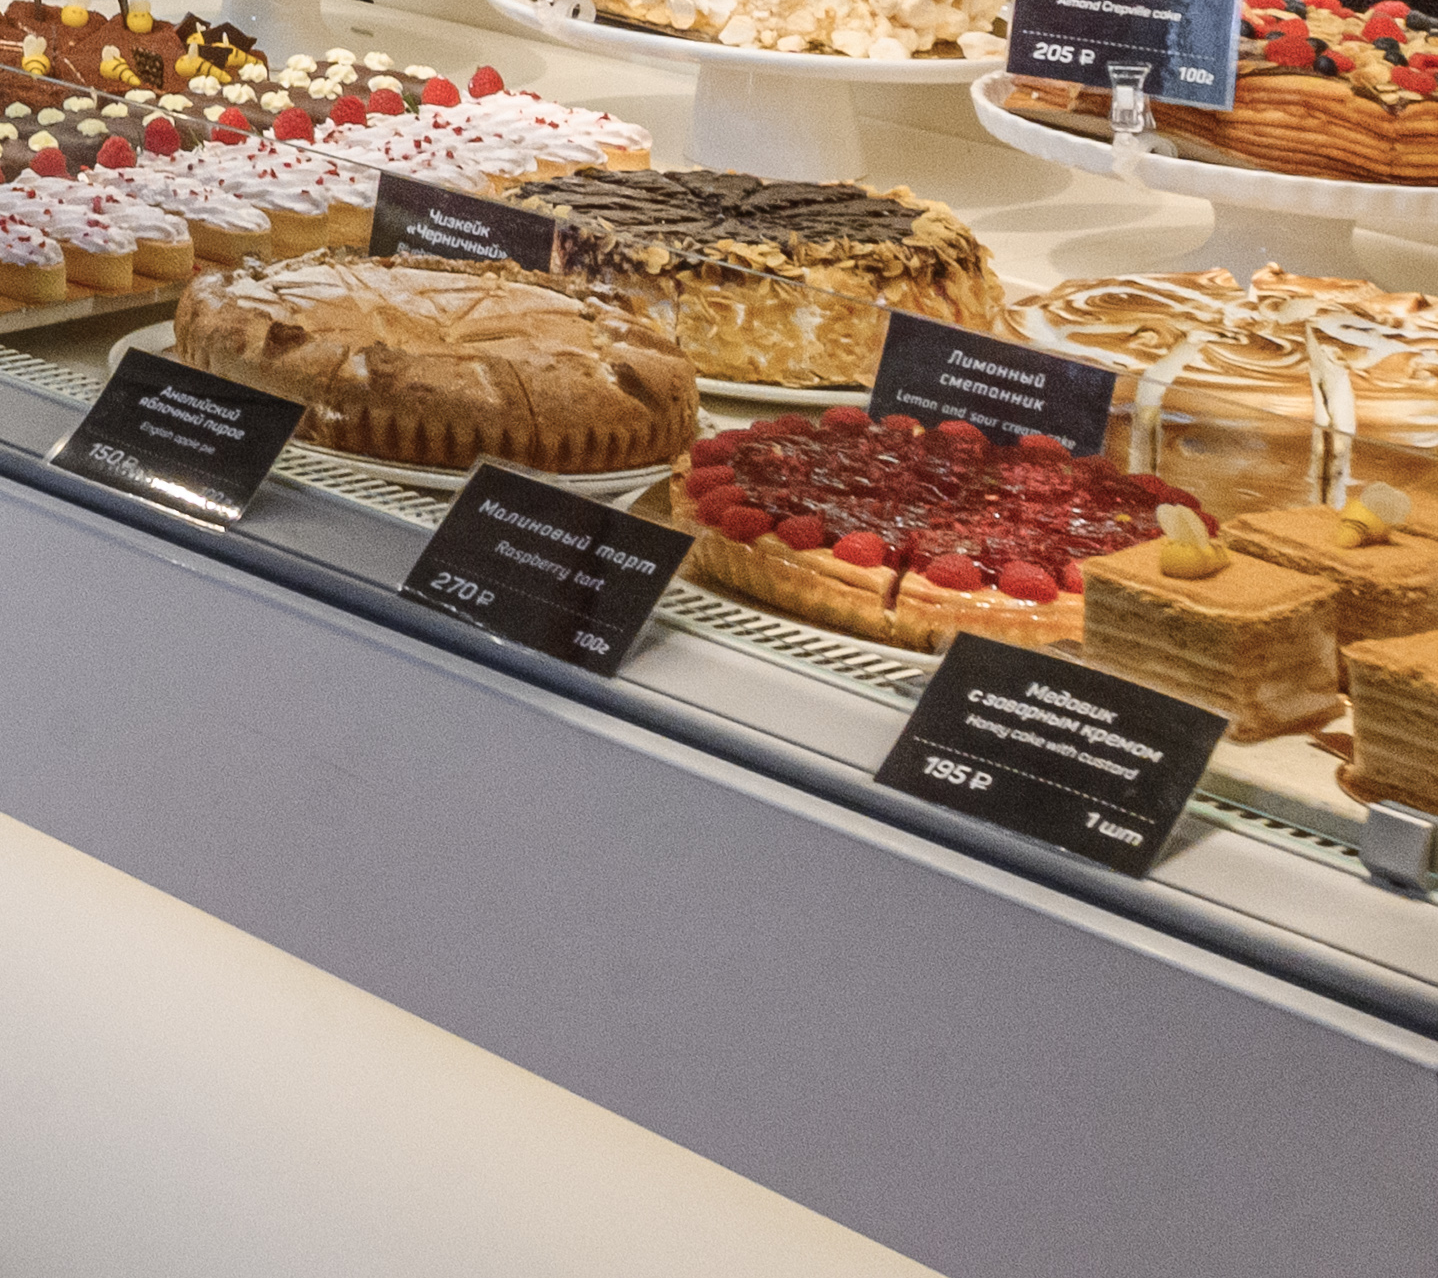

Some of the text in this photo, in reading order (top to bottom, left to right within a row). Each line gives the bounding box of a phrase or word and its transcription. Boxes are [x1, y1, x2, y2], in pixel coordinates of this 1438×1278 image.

[1102, 1, 1152, 18] Crepville
[1152, 8, 1182, 22] cake
[1033, 42, 1075, 63] 205
[406, 222, 508, 259] «Черничный»
[429, 208, 490, 238] Чизкейк
[947, 349, 1046, 389] Лимонный
[160, 385, 242, 422] Английский
[896, 388, 938, 411] Lemon
[941, 403, 967, 419] and
[969, 412, 999, 428] sour
[939, 373, 1045, 412] сметанник
[139, 396, 245, 440] яблочный пирог
[478, 499, 657, 576] Малиновый тарт
[494, 540, 606, 592] Raspberry tart
[1025, 681, 1119, 725] Медовик
[967, 689, 1164, 763] с заварным кремом
[965, 713, 1140, 781] Honey cake with custard
[923, 756, 972, 785] 195
[1085, 812, 1144, 846] 1 шт
